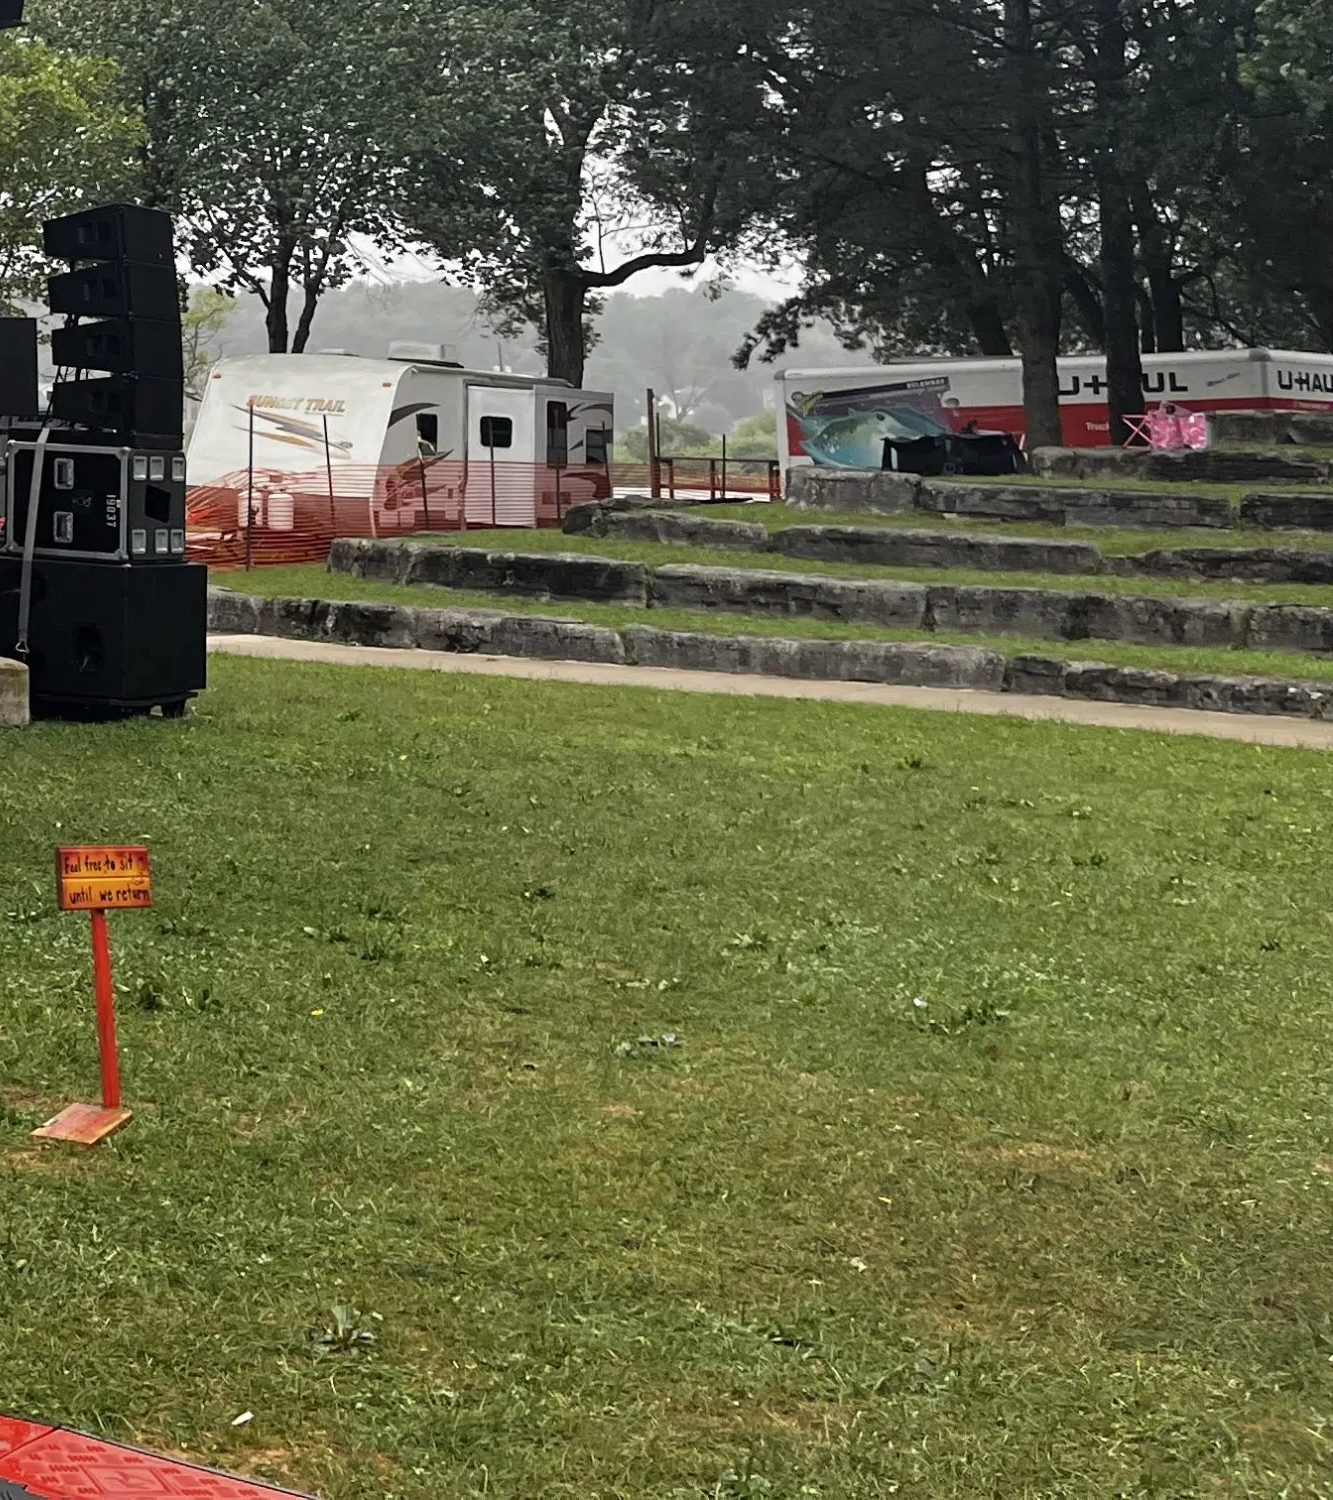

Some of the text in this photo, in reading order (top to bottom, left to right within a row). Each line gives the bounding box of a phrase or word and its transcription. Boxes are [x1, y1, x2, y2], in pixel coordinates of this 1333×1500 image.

[305, 398, 345, 412] TRAIL
[106, 494, 117, 528] 19037
[64, 853, 133, 874] Feel free to sit
[69, 884, 149, 904] until we return
